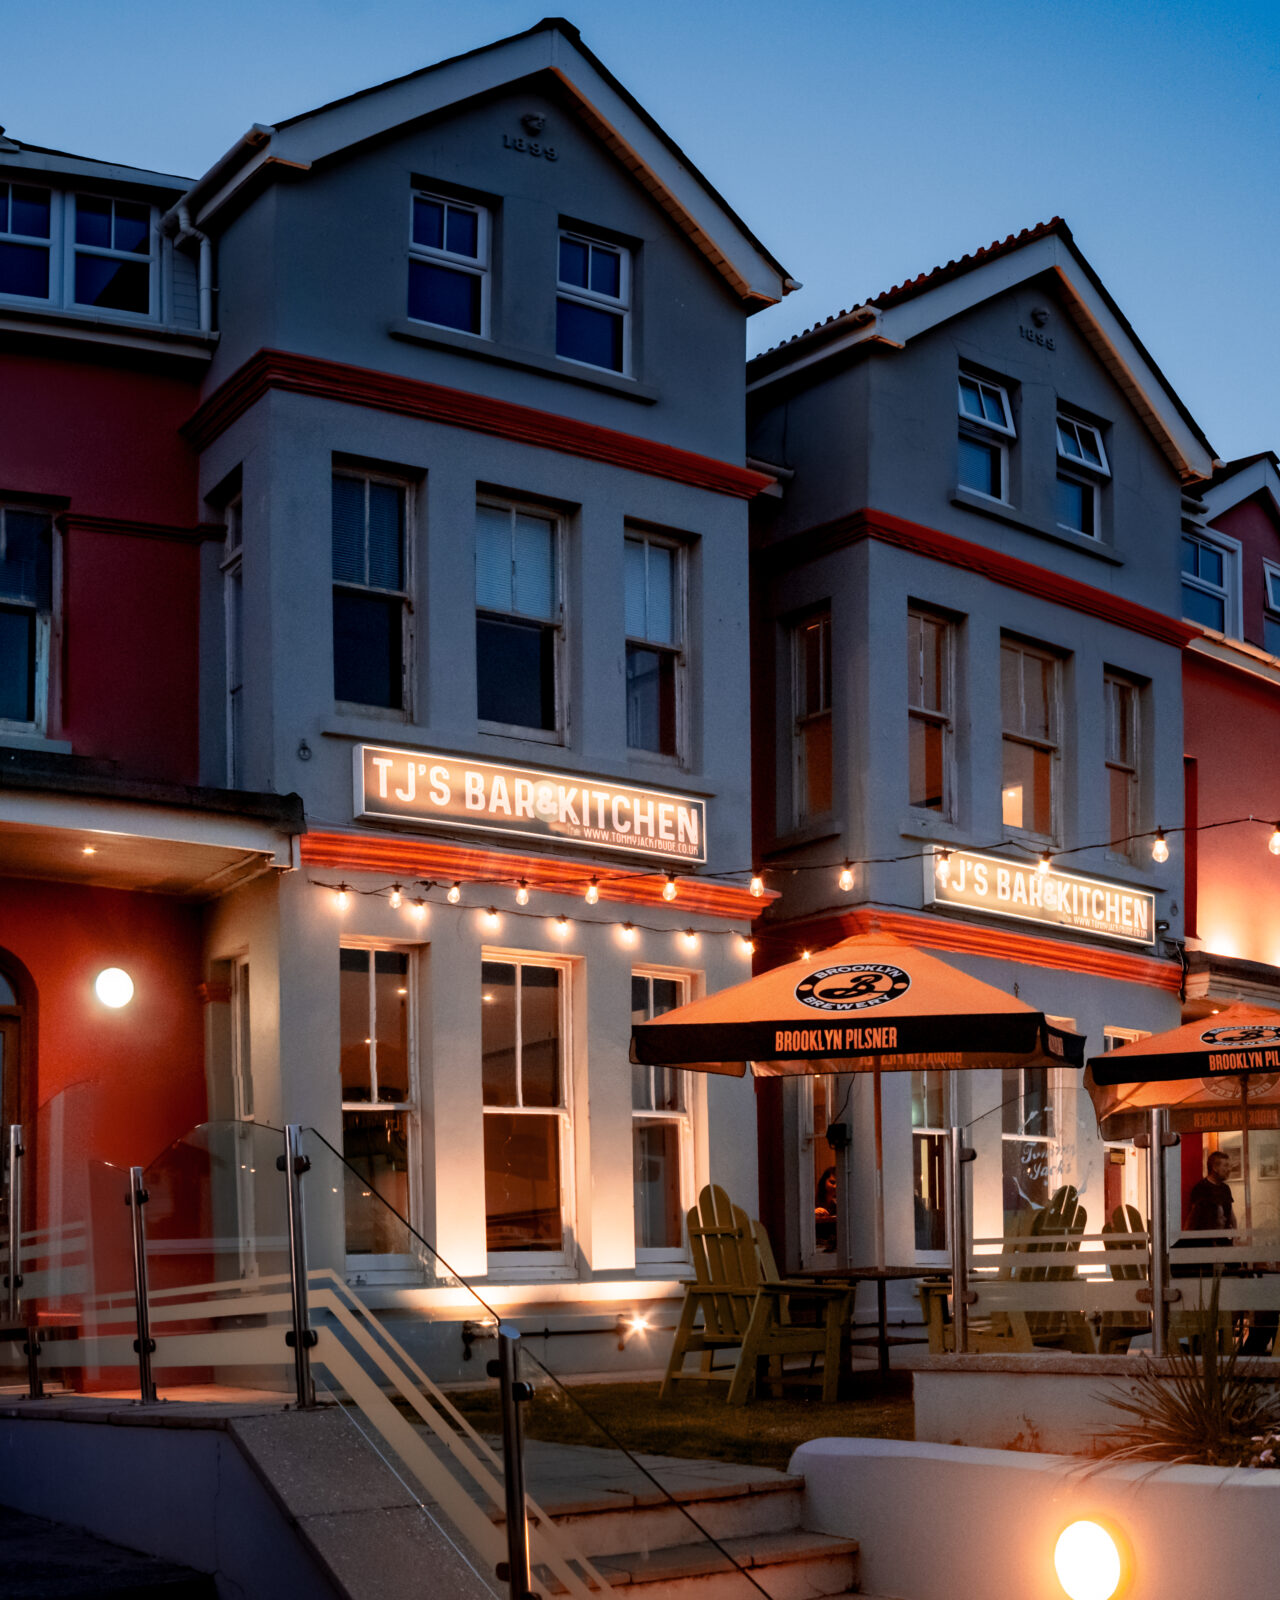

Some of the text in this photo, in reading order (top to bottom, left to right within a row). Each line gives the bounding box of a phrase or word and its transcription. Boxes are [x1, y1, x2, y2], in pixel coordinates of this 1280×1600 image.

[503, 133, 560, 162] 1899
[373, 757, 450, 806] TJ'S
[558, 787, 698, 845] KITCHEN
[813, 963, 903, 980] BROOKLYN
[802, 993, 891, 1011] BREWERY
[775, 1027, 898, 1052] BROOKLYN PILSNER
[1208, 1051, 1263, 1071] BROOKLYN
